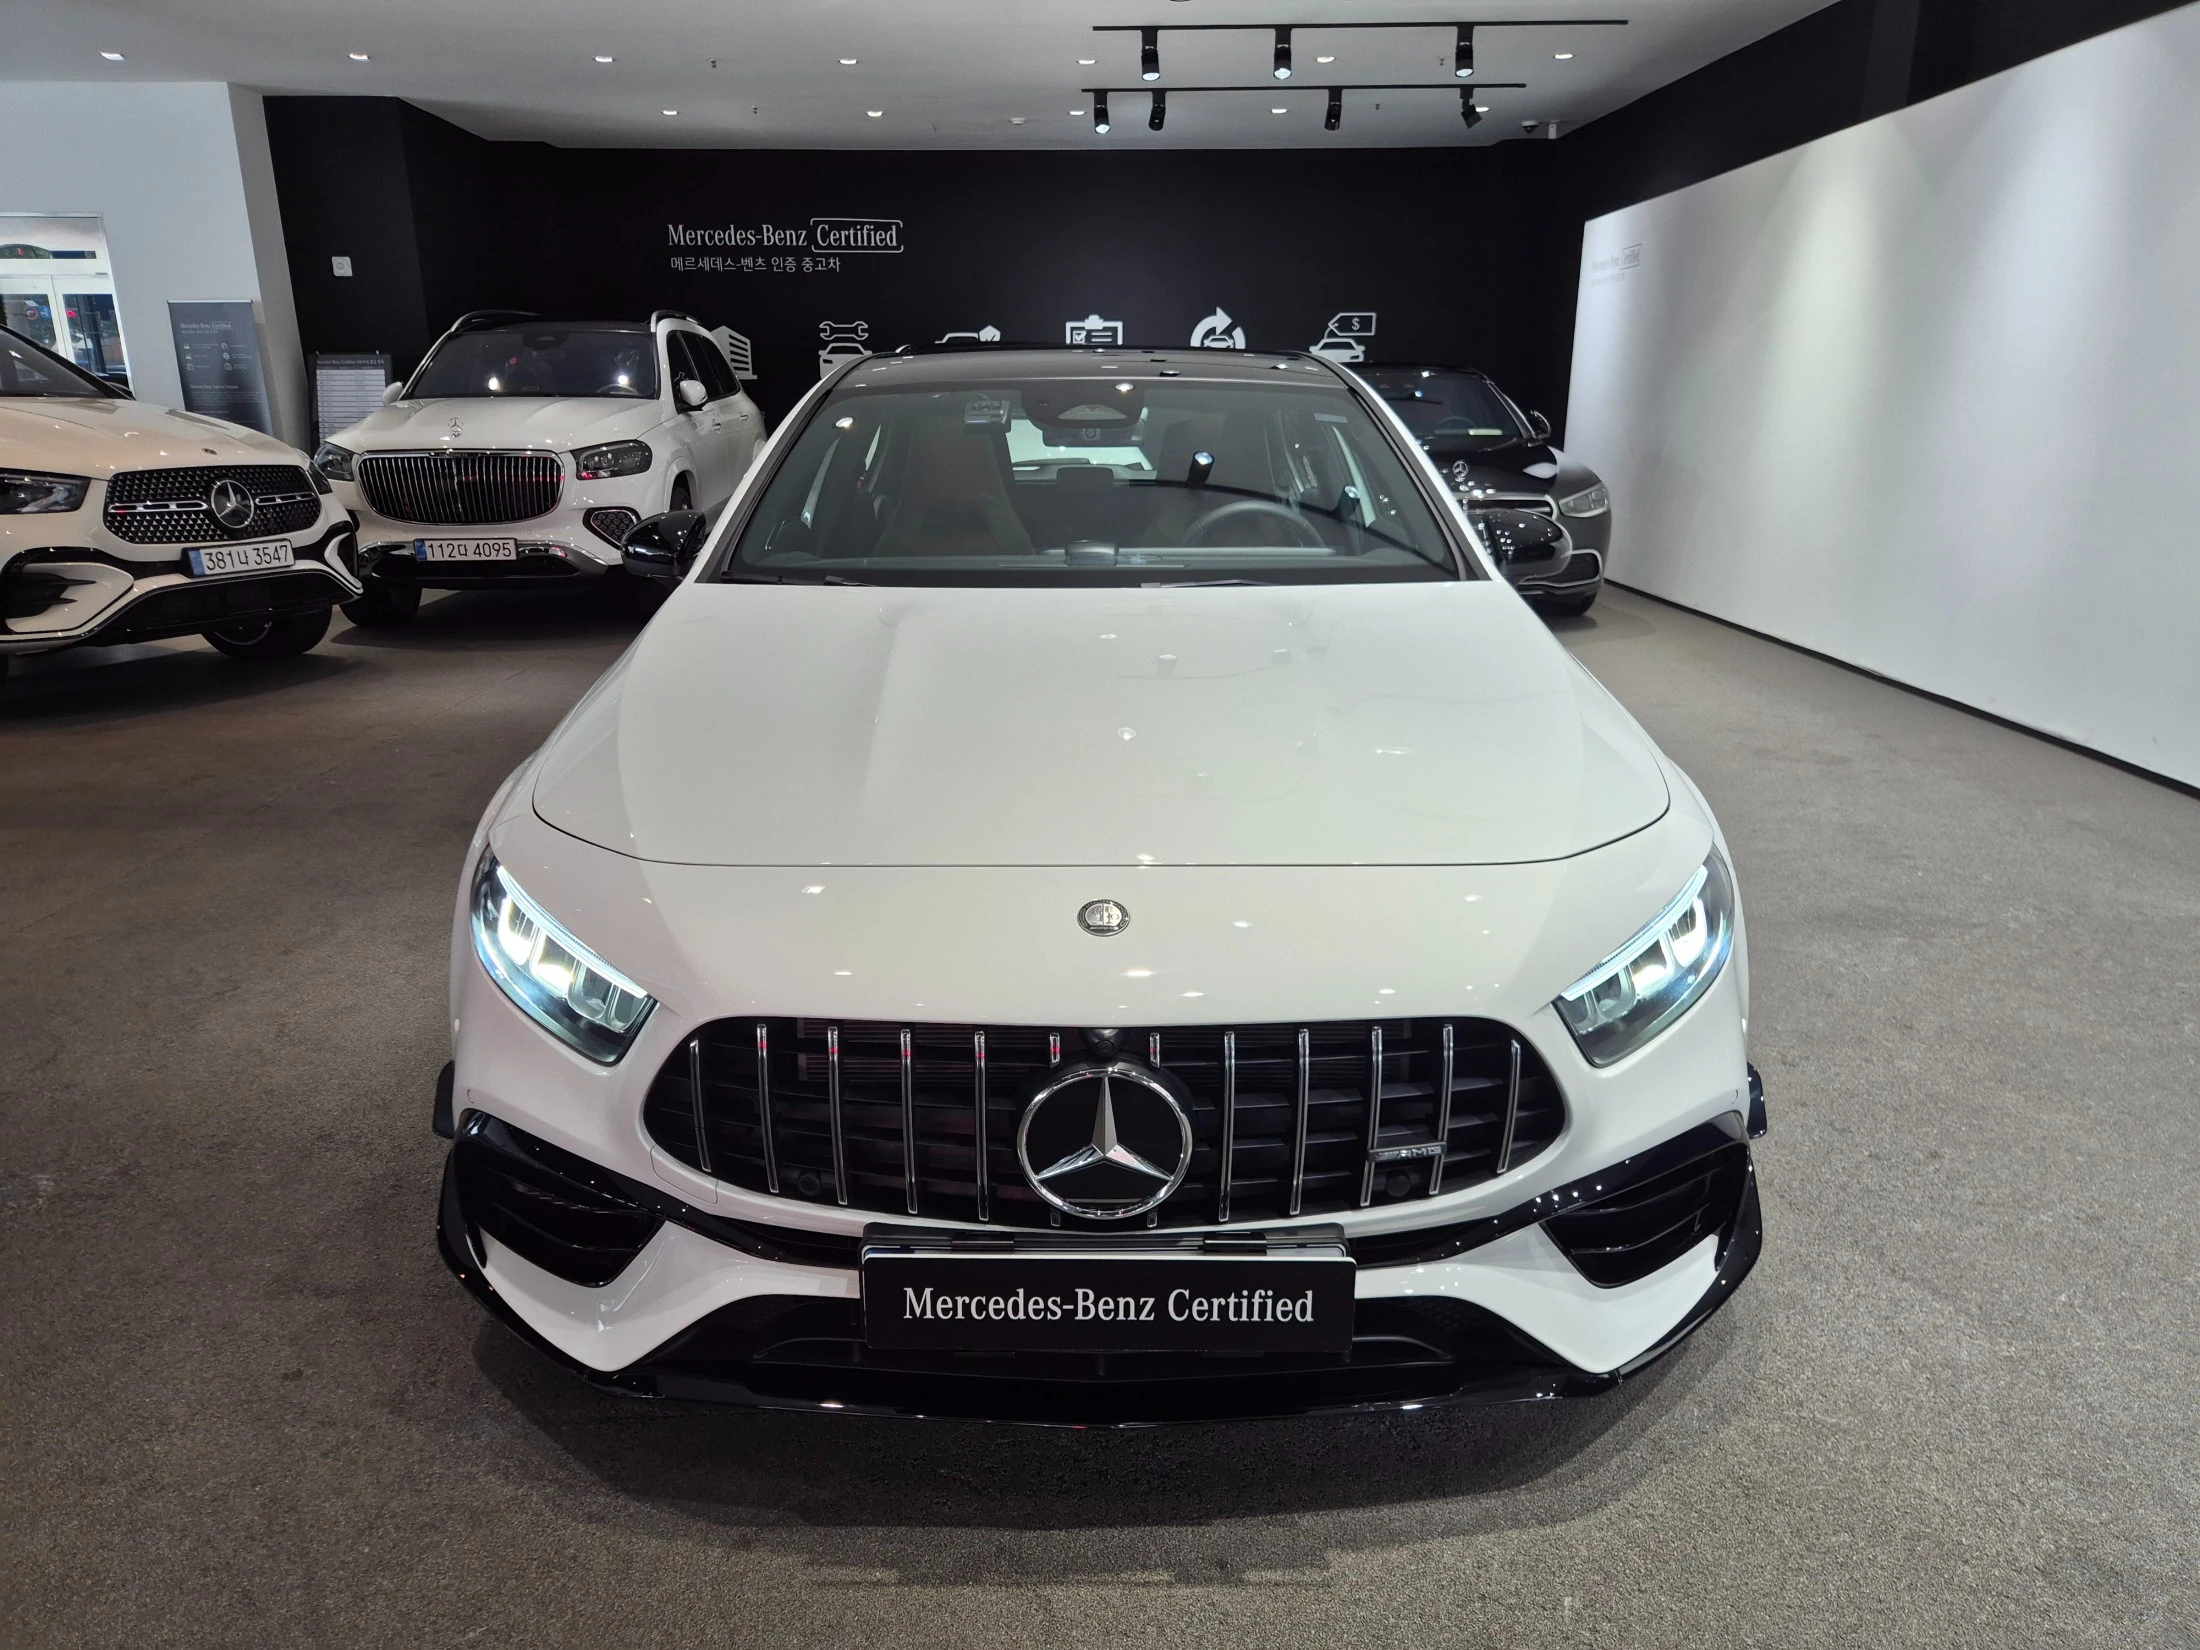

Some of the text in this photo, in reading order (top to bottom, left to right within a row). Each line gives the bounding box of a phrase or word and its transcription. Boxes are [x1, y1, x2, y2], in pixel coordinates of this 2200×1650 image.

[667, 223, 898, 247] Mercedes-Benz Certified
[670, 256, 841, 273] 메르세데스-벤츠 인증 중고차
[204, 544, 288, 571] 381나 3547
[427, 542, 512, 559] 112다 4095
[1398, 1146, 1442, 1158] AMG
[903, 1286, 1315, 1323] Mercedes-Benz Certified
